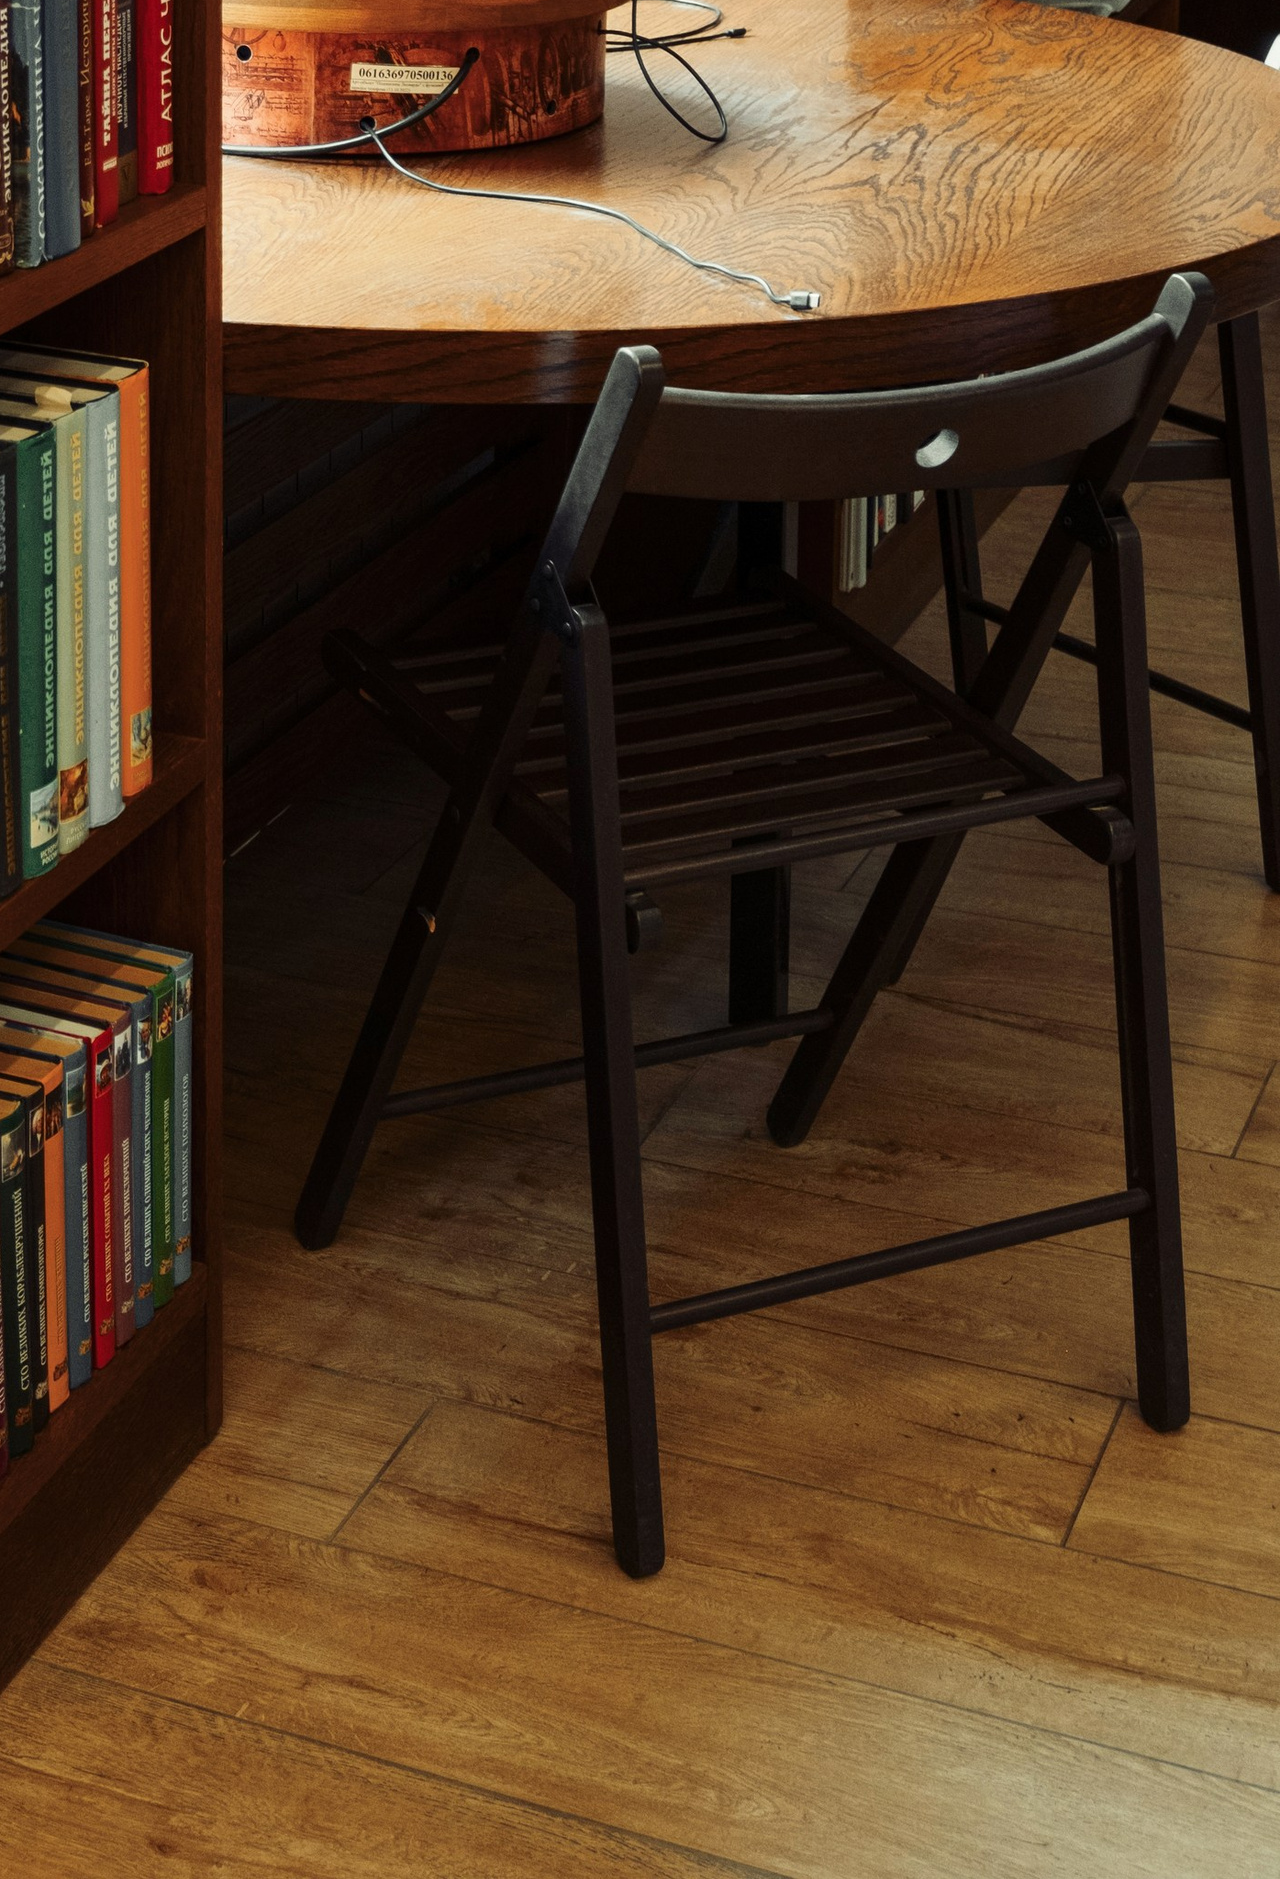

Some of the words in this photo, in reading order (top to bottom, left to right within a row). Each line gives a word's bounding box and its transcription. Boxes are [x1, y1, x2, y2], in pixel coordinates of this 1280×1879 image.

[0, 6, 13, 202] ЭНЦИКЛОПЕДИЯ
[102, 63, 112, 146] ТАЙНА
[160, 24, 173, 122] АТЛАС
[358, 67, 453, 81] 061636970500136
[39, 449, 53, 522] ДЕТЕЙ
[103, 420, 120, 503] ДЕТЕЙ
[42, 532, 54, 576] ДЛЯ
[106, 513, 120, 568] ДЛЯ
[41, 583, 56, 769] ЭНЦИКЛОПЕДИЯ
[106, 576, 122, 792] ЭНЦИКЛОПЕДИЯ
[11, 1187, 27, 1307] КОРАБЛЕКРУШЕНИЙ
